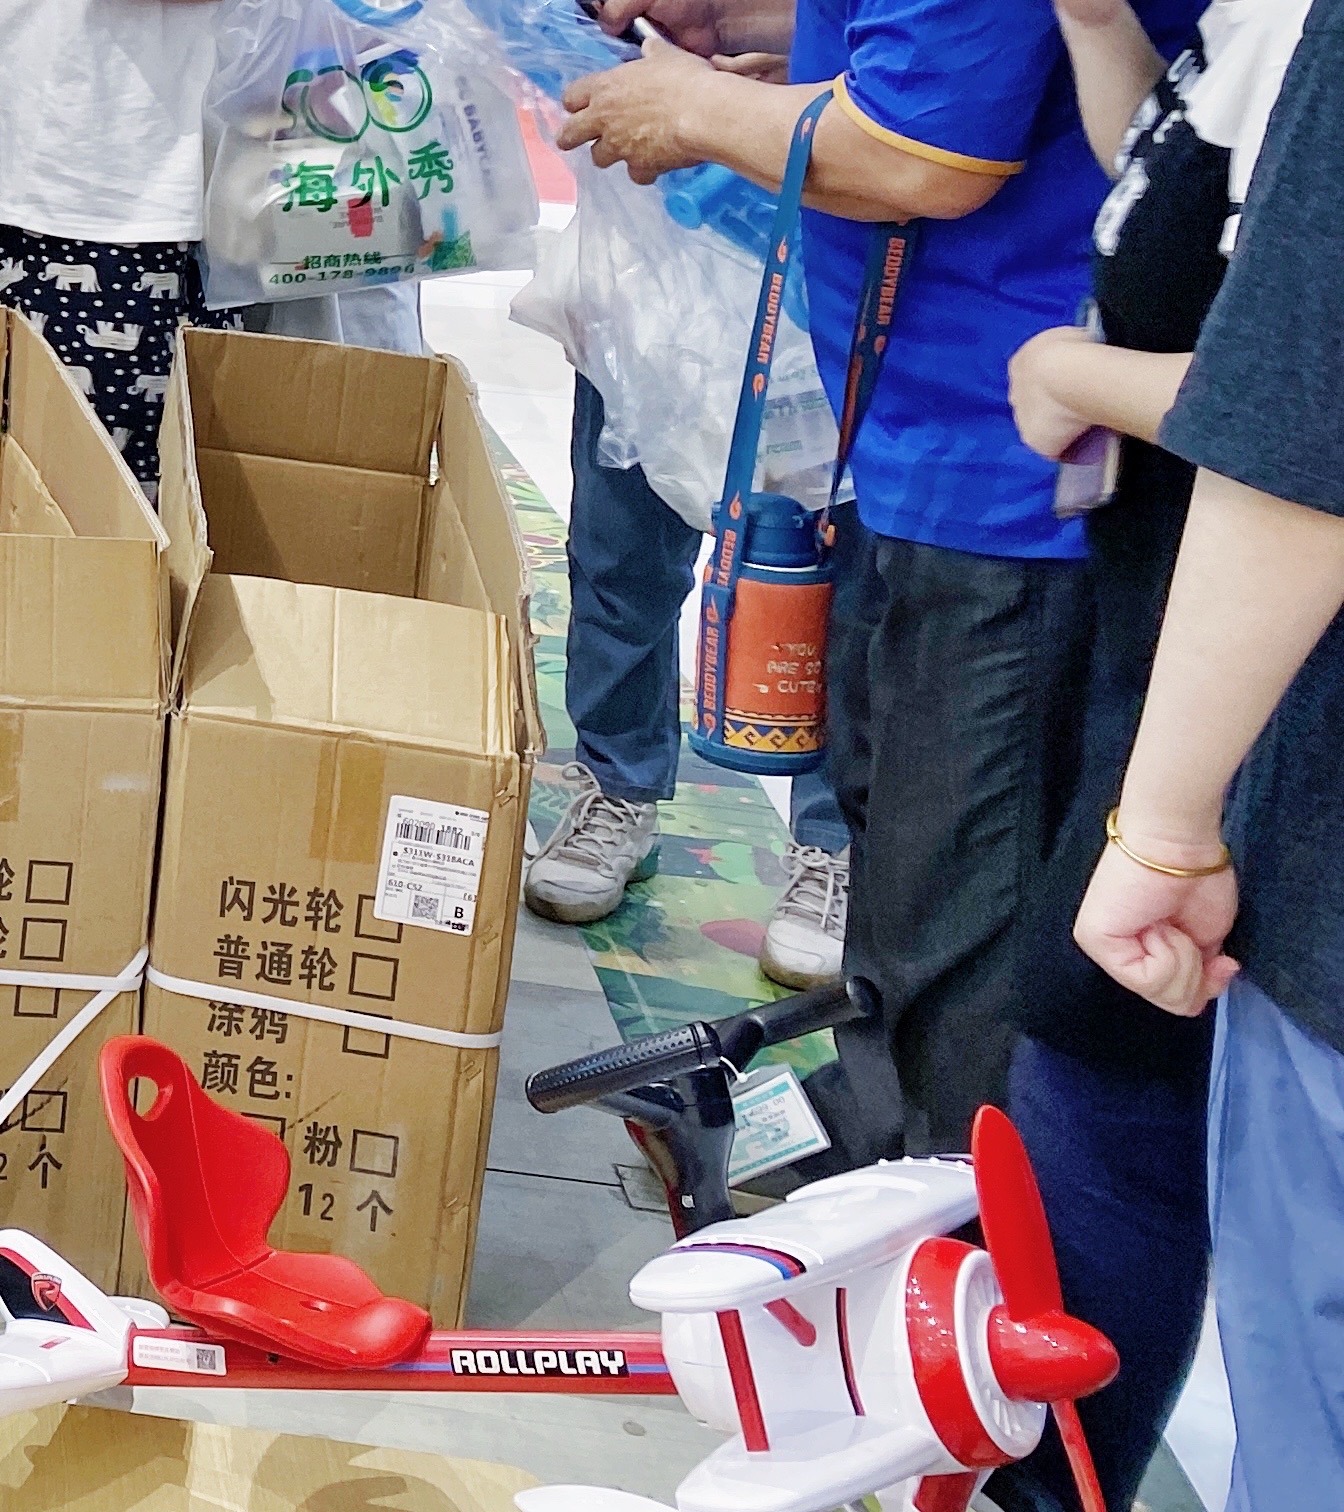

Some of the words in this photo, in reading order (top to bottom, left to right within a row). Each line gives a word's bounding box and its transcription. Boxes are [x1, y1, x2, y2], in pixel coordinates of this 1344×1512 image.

[277, 139, 454, 213] 海外秀
[304, 251, 383, 270] 招商热线
[766, 661, 799, 675] ARE
[787, 642, 815, 657] YOU
[219, 876, 344, 933] 闪光轮
[454, 906, 464, 919] B
[213, 934, 338, 992] 普通轮
[207, 1001, 288, 1044] 涂鸦
[303, 1121, 343, 1167] 粉
[27, 1149, 63, 1189] 个
[356, 1190, 394, 1232] 个
[450, 1349, 625, 1375] ROLLPLAY
